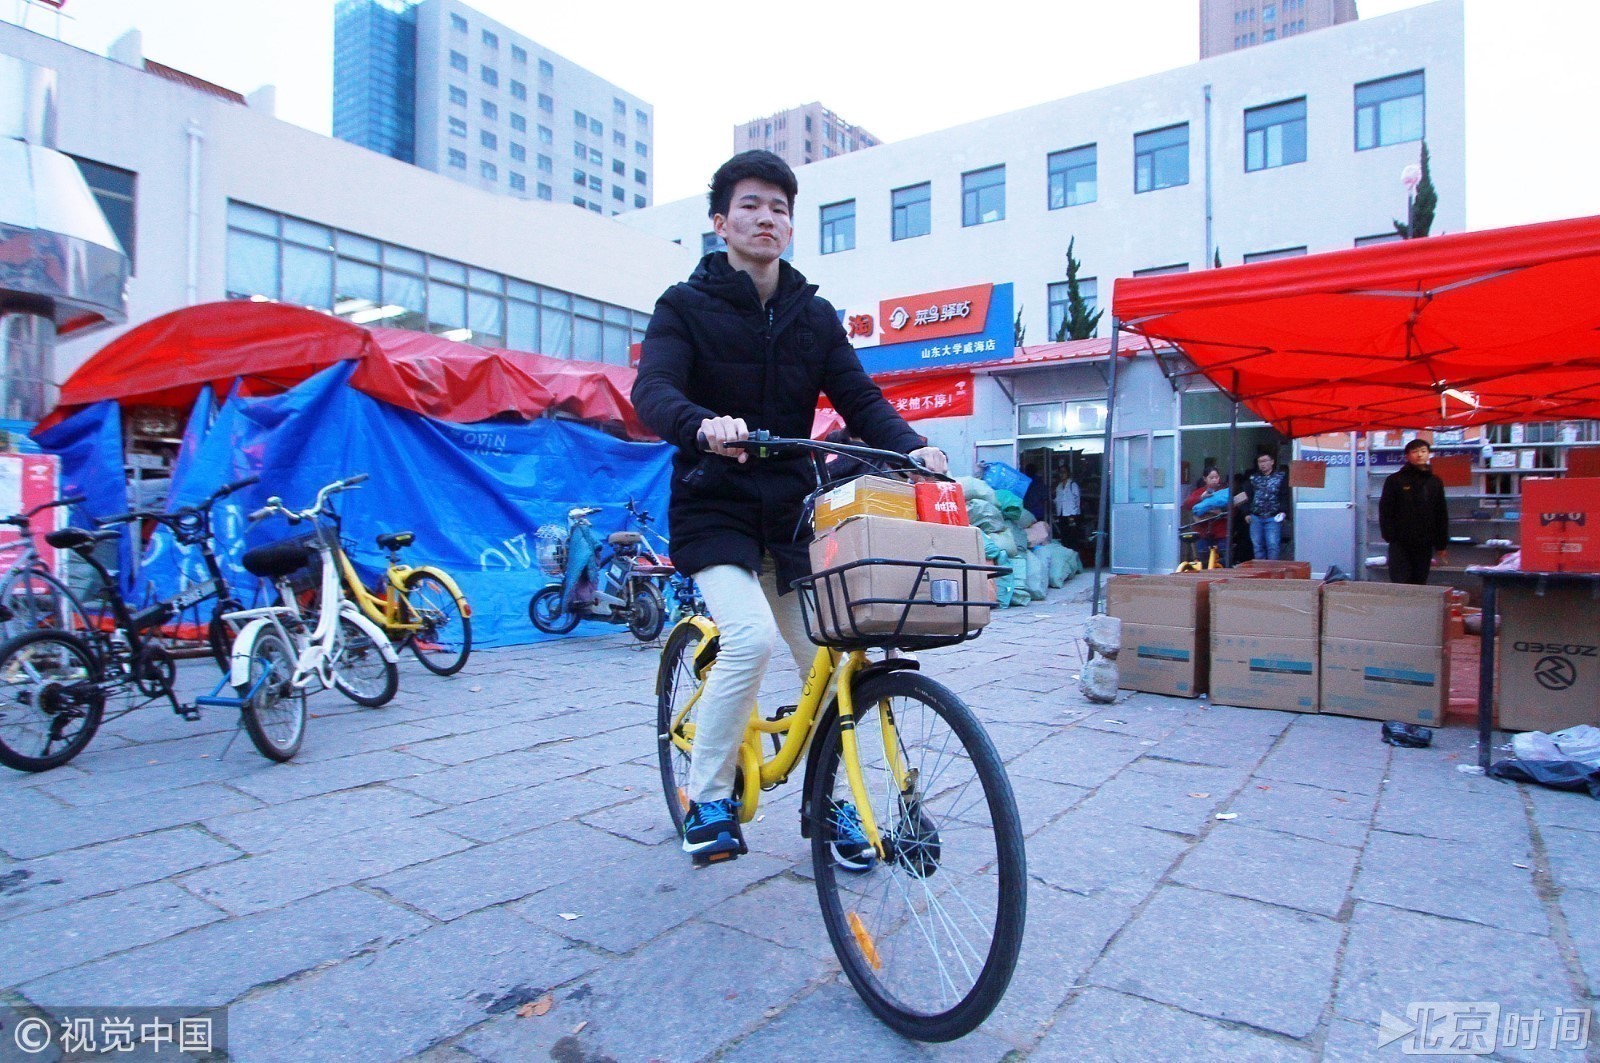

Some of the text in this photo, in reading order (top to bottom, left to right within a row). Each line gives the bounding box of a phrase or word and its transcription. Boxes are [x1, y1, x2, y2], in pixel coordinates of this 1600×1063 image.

[914, 301, 971, 326] 菜鸟驿站
[921, 339, 996, 359] 山东大学威海店
